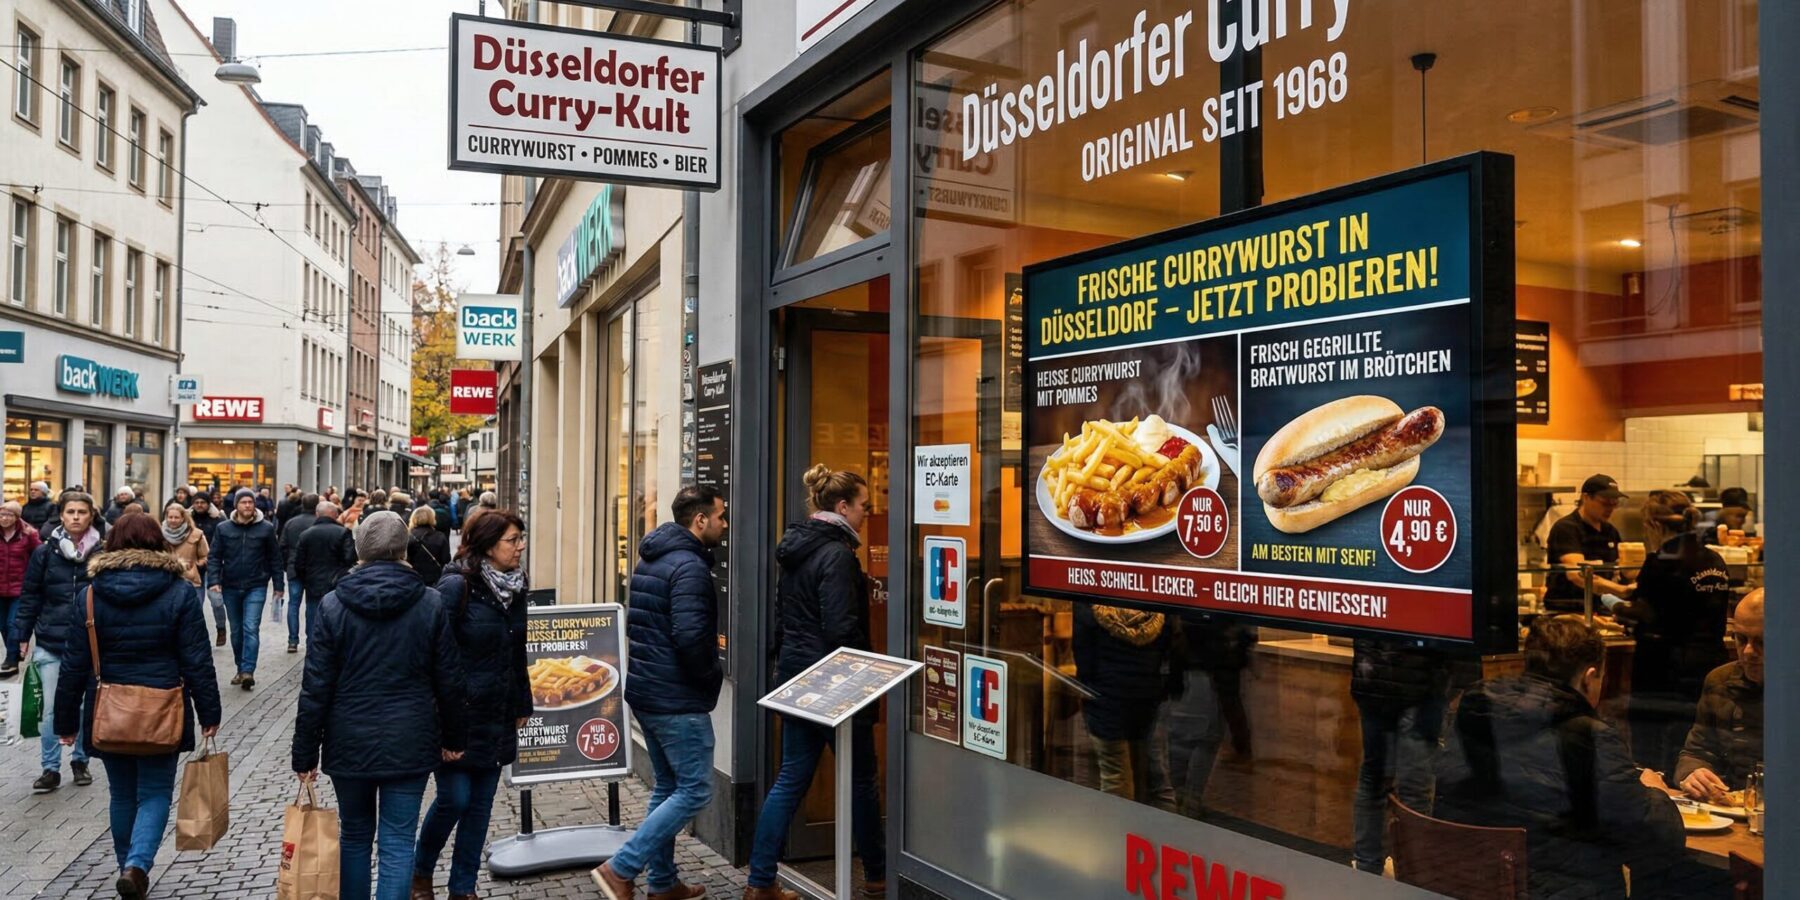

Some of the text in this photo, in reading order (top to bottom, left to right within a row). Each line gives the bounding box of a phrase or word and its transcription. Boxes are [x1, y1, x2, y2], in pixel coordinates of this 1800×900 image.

[473, 34, 705, 95] Düsseldorfer
[962, 9, 1193, 161] Düsseldorfer
[489, 79, 690, 135] Curry-Kult
[1081, 51, 1348, 183] ORIGINAL SEIT 1968
[468, 134, 708, 174] CURRYWURST POMMES BIER
[1077, 212, 1369, 305] FRISCHE CURRYWURST IN
[1040, 298, 1158, 346] DÜSSELDORF
[1186, 280, 1255, 325] JETZT
[1266, 246, 1439, 312] PROBIEREN!
[464, 308, 516, 328] back
[463, 331, 516, 347] WERK
[1250, 330, 1382, 364] FRISCH GEGRILLTE
[1037, 360, 1142, 388] HEISSE CURRYWURST
[1250, 348, 1452, 388] BRATWURST IM BRÖTCHEN
[452, 385, 494, 398] REWE
[1037, 385, 1098, 407] MIT POMMES
[195, 398, 260, 418] REWE
[917, 453, 968, 470] Wir akzeptieren
[925, 472, 959, 487] EC-Karte
[1192, 497, 1212, 512] NUR
[1404, 499, 1431, 517] NUR
[1184, 514, 1222, 546] 7,50 €
[1390, 520, 1447, 557] 4,90 €
[1252, 544, 1377, 566] AM BESTEN MIT SENF!
[931, 546, 958, 602] EC
[1067, 566, 1098, 588] HEISS.
[1100, 570, 1149, 593] SCHNELL.
[1152, 575, 1198, 598] LECKER.
[1214, 581, 1259, 605] GLEICH
[1263, 585, 1294, 608] HIER
[1298, 588, 1387, 620] GENIESSEN!
[551, 616, 613, 629] CURRYWURST
[970, 666, 999, 724] EC
[518, 725, 569, 737] CURRYWURST
[518, 735, 567, 747] MIT POMMES
[590, 724, 605, 733] NUR
[581, 733, 615, 753] 7,50 €
